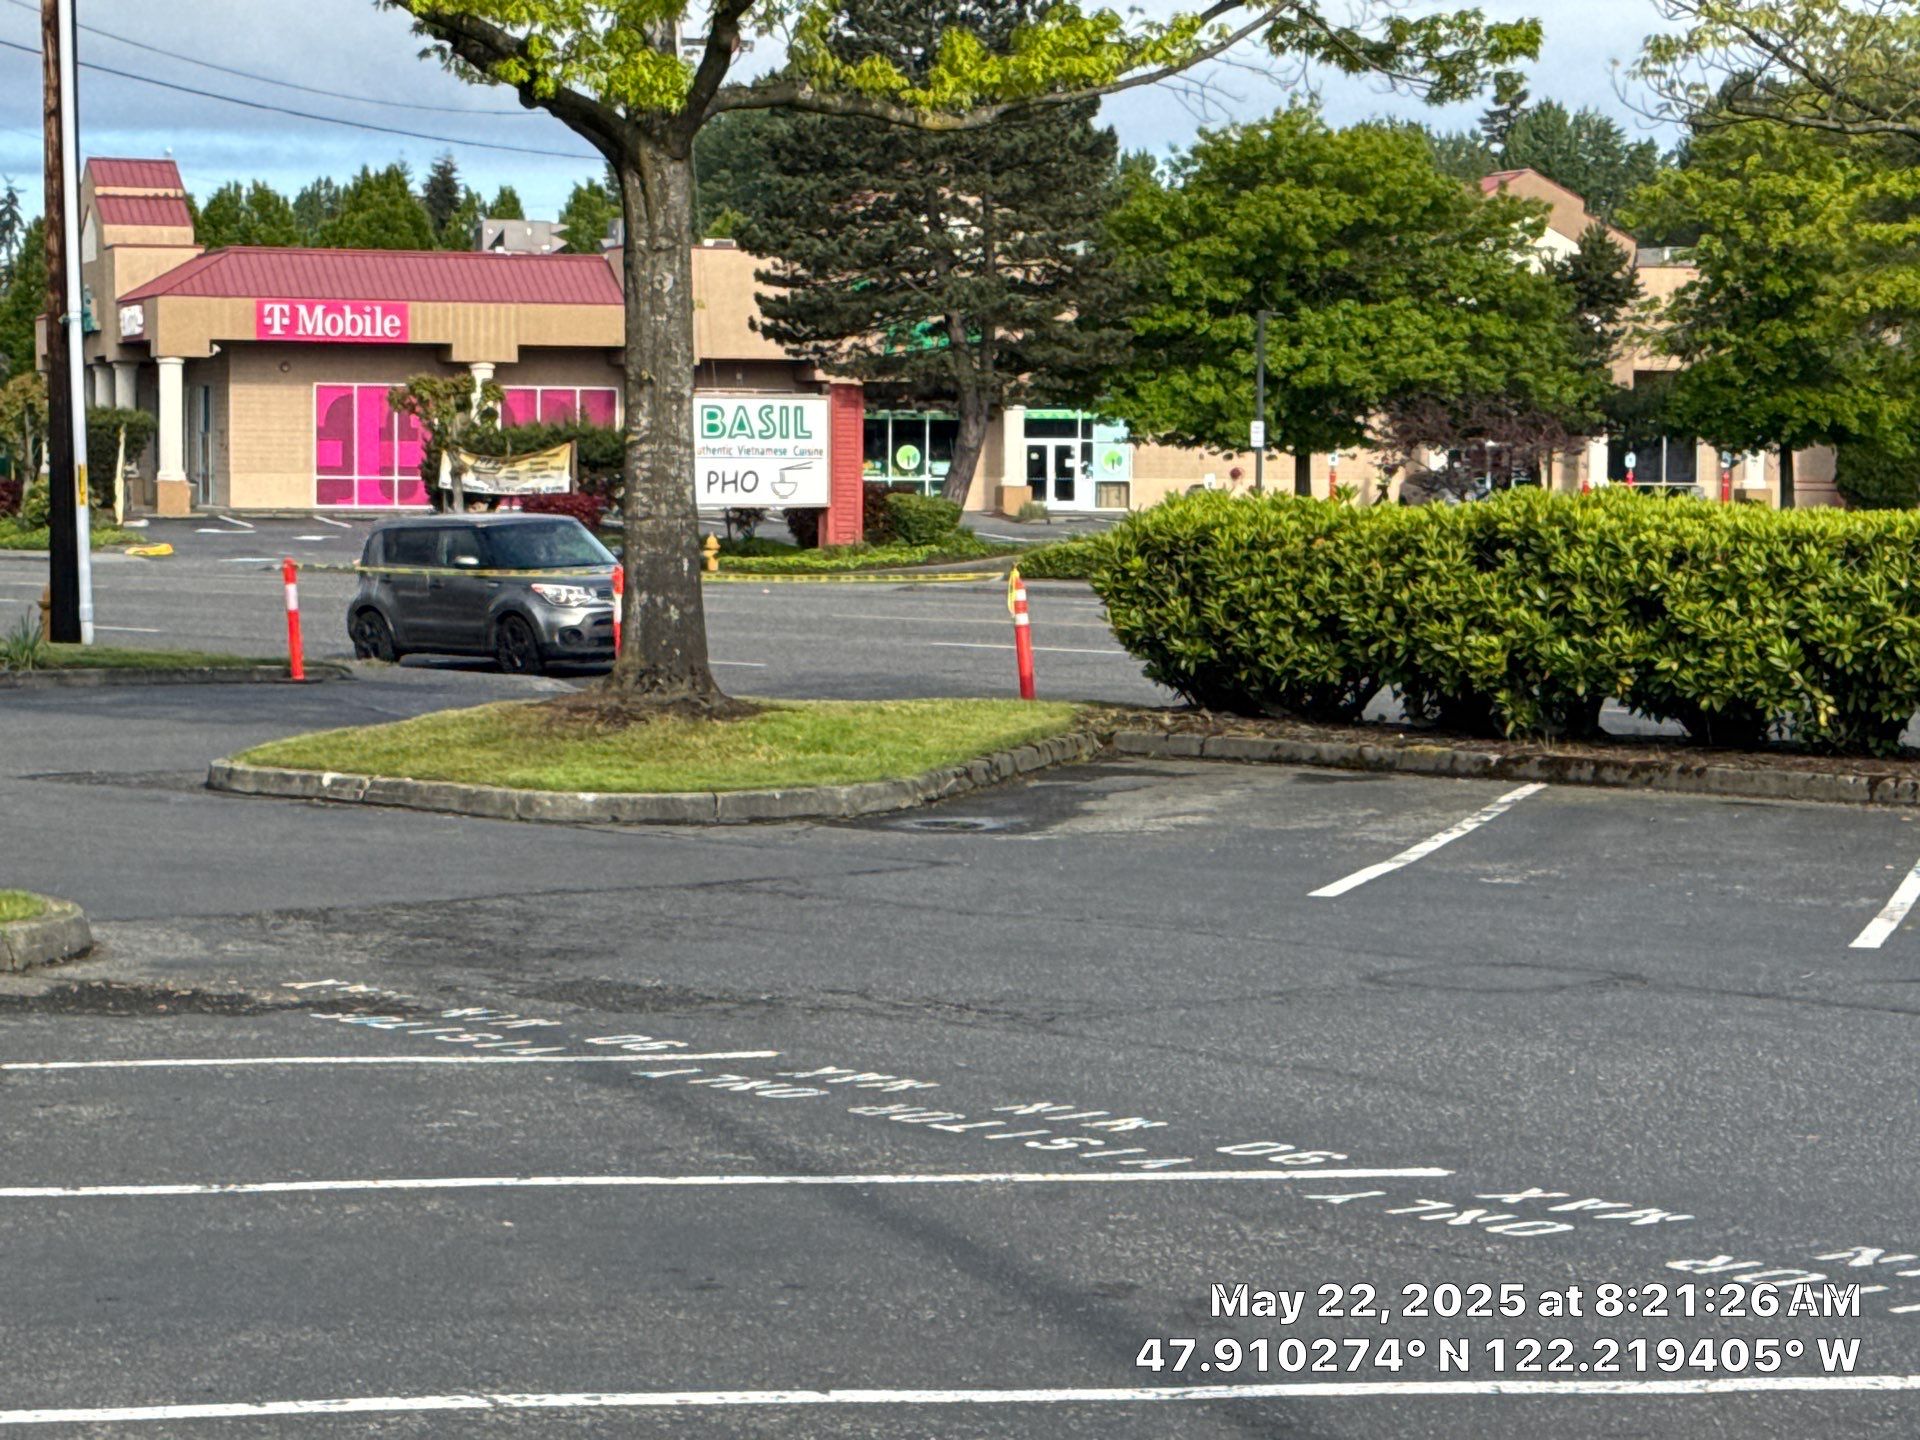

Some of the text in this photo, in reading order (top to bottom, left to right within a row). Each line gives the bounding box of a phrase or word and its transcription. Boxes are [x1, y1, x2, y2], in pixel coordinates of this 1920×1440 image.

[263, 303, 402, 338] T Mobile
[700, 404, 812, 440] BASIL
[737, 445, 788, 457] Vietnamese
[793, 445, 824, 457] Cuisine
[706, 470, 759, 494] PHO
